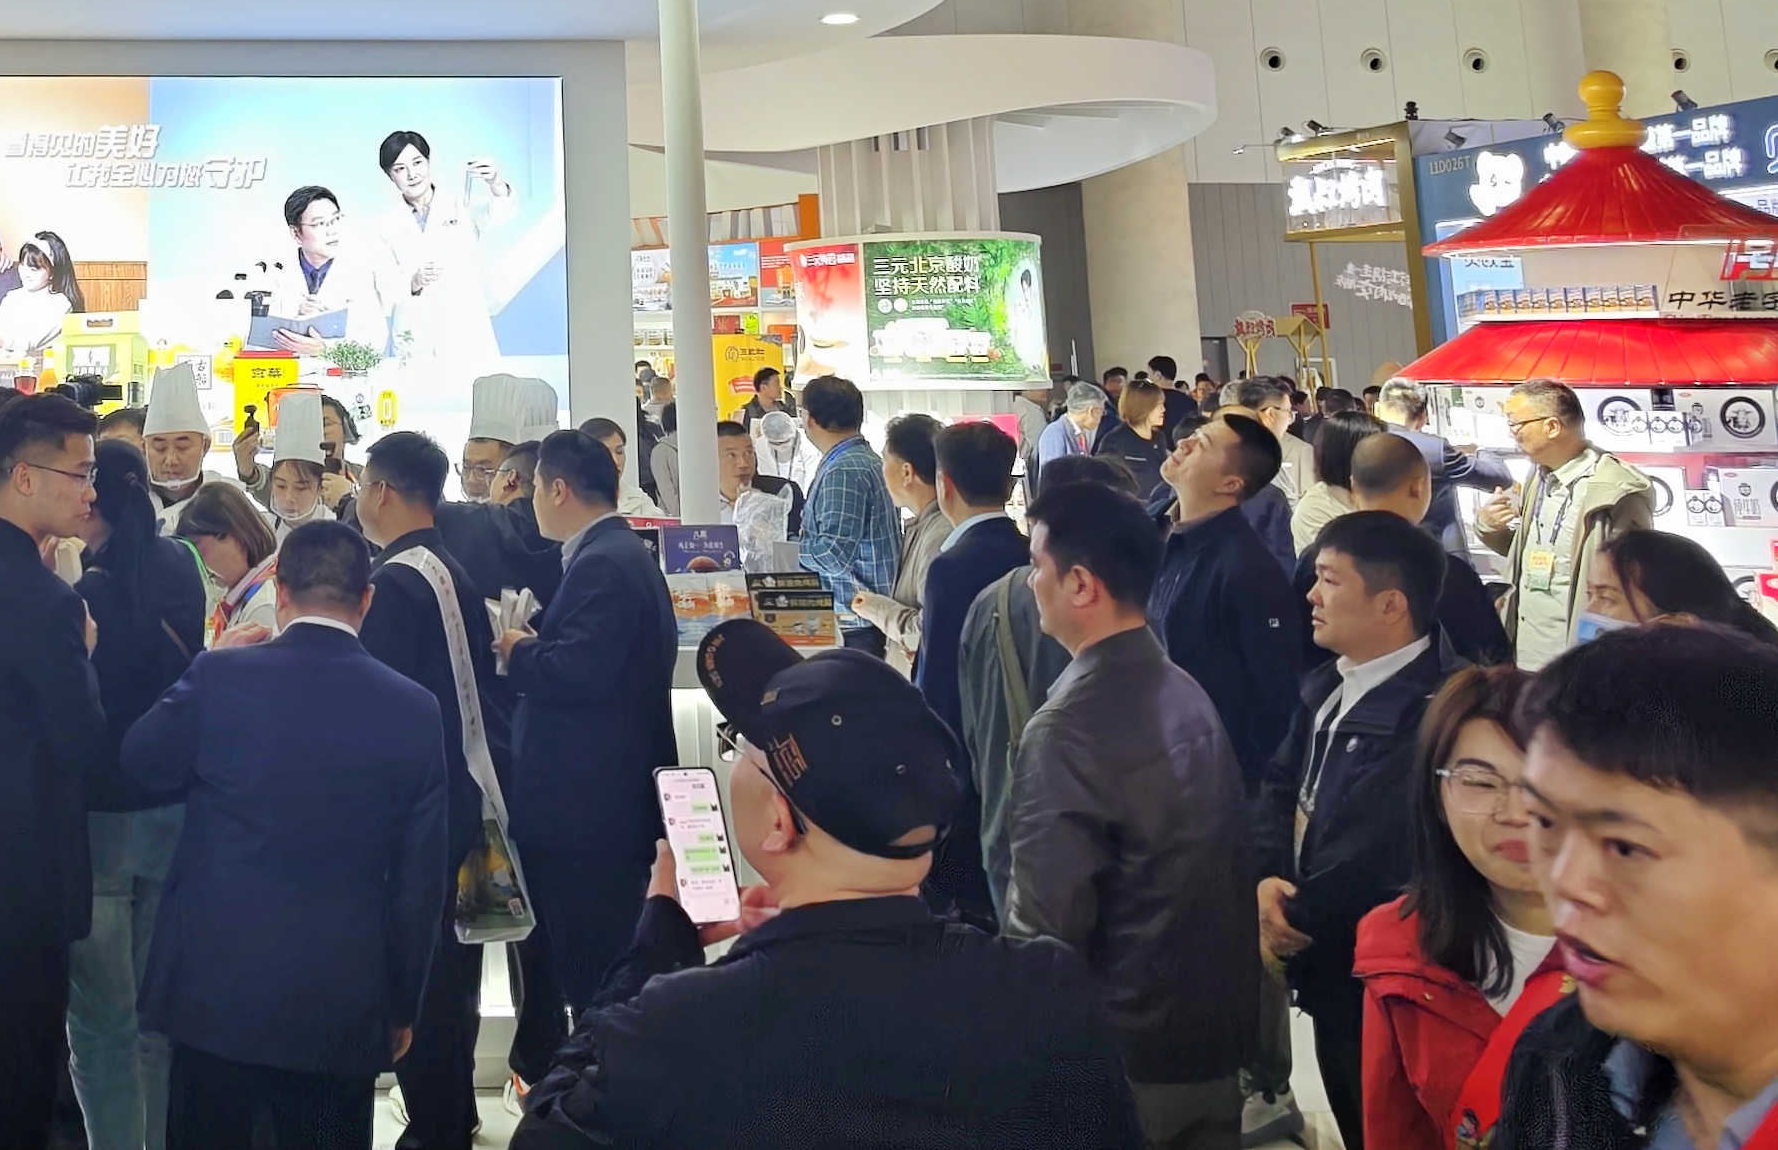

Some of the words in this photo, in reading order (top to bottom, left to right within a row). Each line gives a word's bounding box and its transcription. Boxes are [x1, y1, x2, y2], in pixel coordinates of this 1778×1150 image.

[4, 124, 163, 160] 看得见的美好
[65, 155, 268, 189] 让我全心为您守护
[872, 255, 981, 275] 三元北京酸奶
[874, 275, 981, 296] 坚持天然配料
